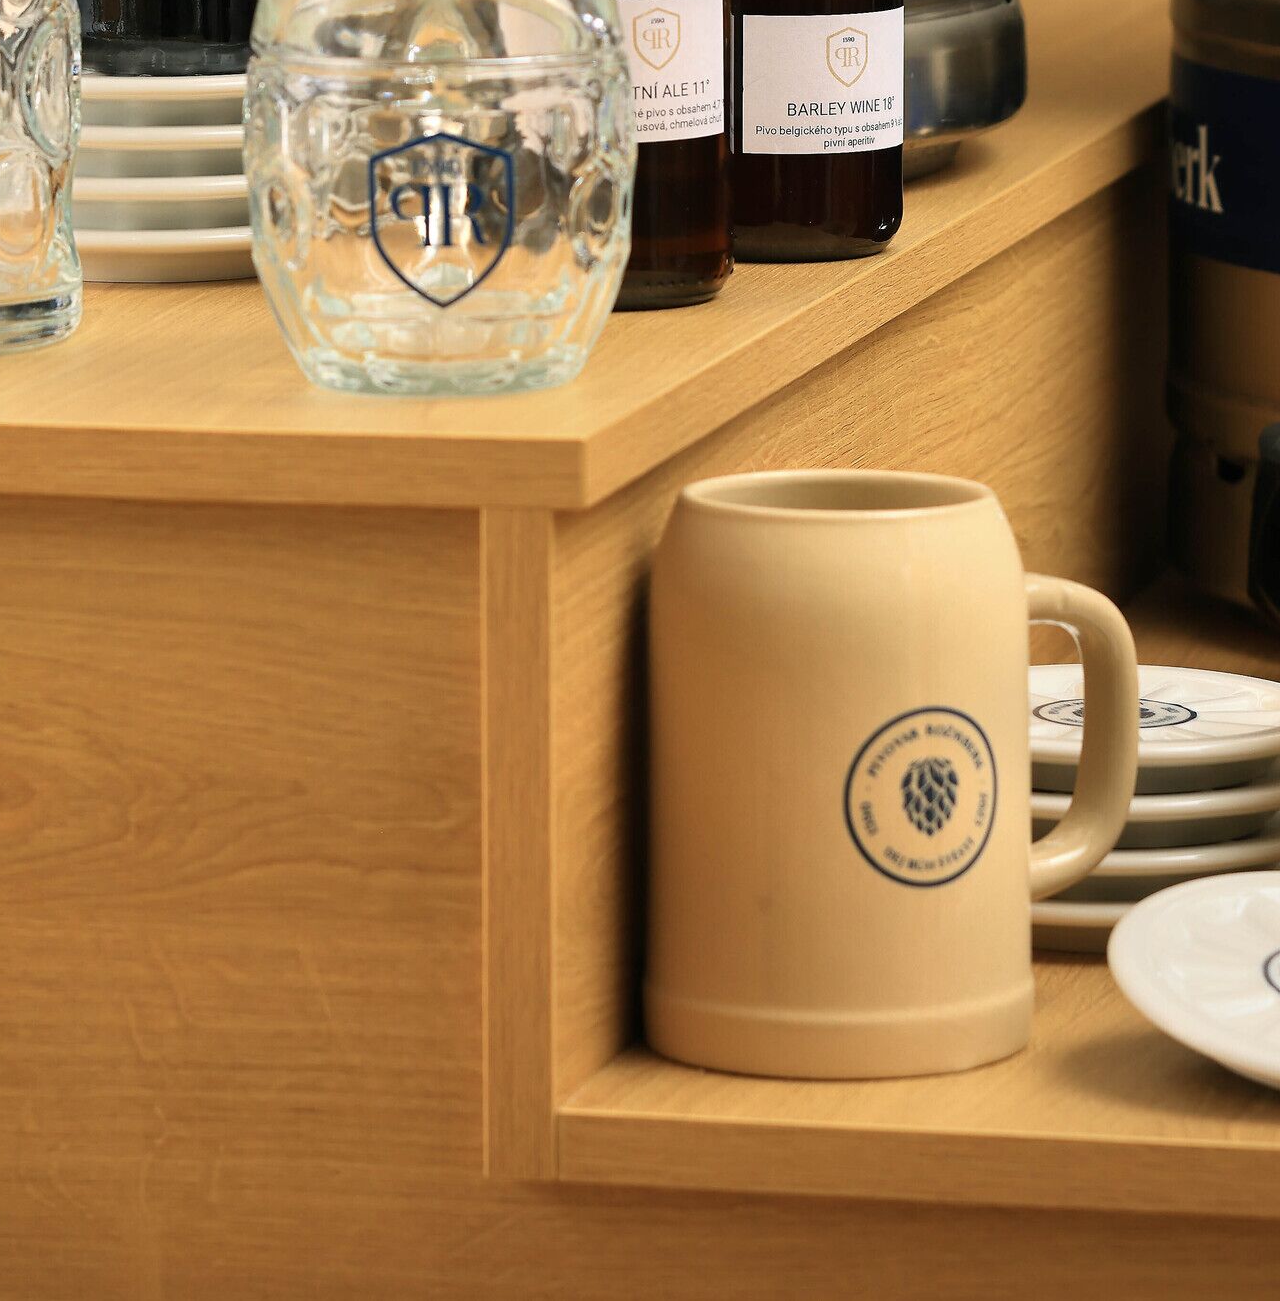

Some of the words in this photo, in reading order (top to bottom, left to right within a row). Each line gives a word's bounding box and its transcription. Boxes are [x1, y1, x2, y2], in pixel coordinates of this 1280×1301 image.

[632, 82, 658, 100] TNÍ
[662, 82, 689, 98] ALE
[646, 108, 667, 120] pivo
[668, 108, 674, 116] s
[676, 103, 711, 115] obsahem
[787, 101, 847, 117] BARLEY
[850, 98, 880, 114] WINE
[636, 122, 668, 132] usová,
[669, 117, 708, 130] chmelová
[755, 125, 777, 135] Pivo
[779, 125, 832, 137] belgického
[834, 125, 853, 136] typu
[855, 125, 860, 133] s
[861, 121, 890, 133] obsahem
[823, 137, 846, 149] pivní
[847, 135, 876, 148] aperitiv
